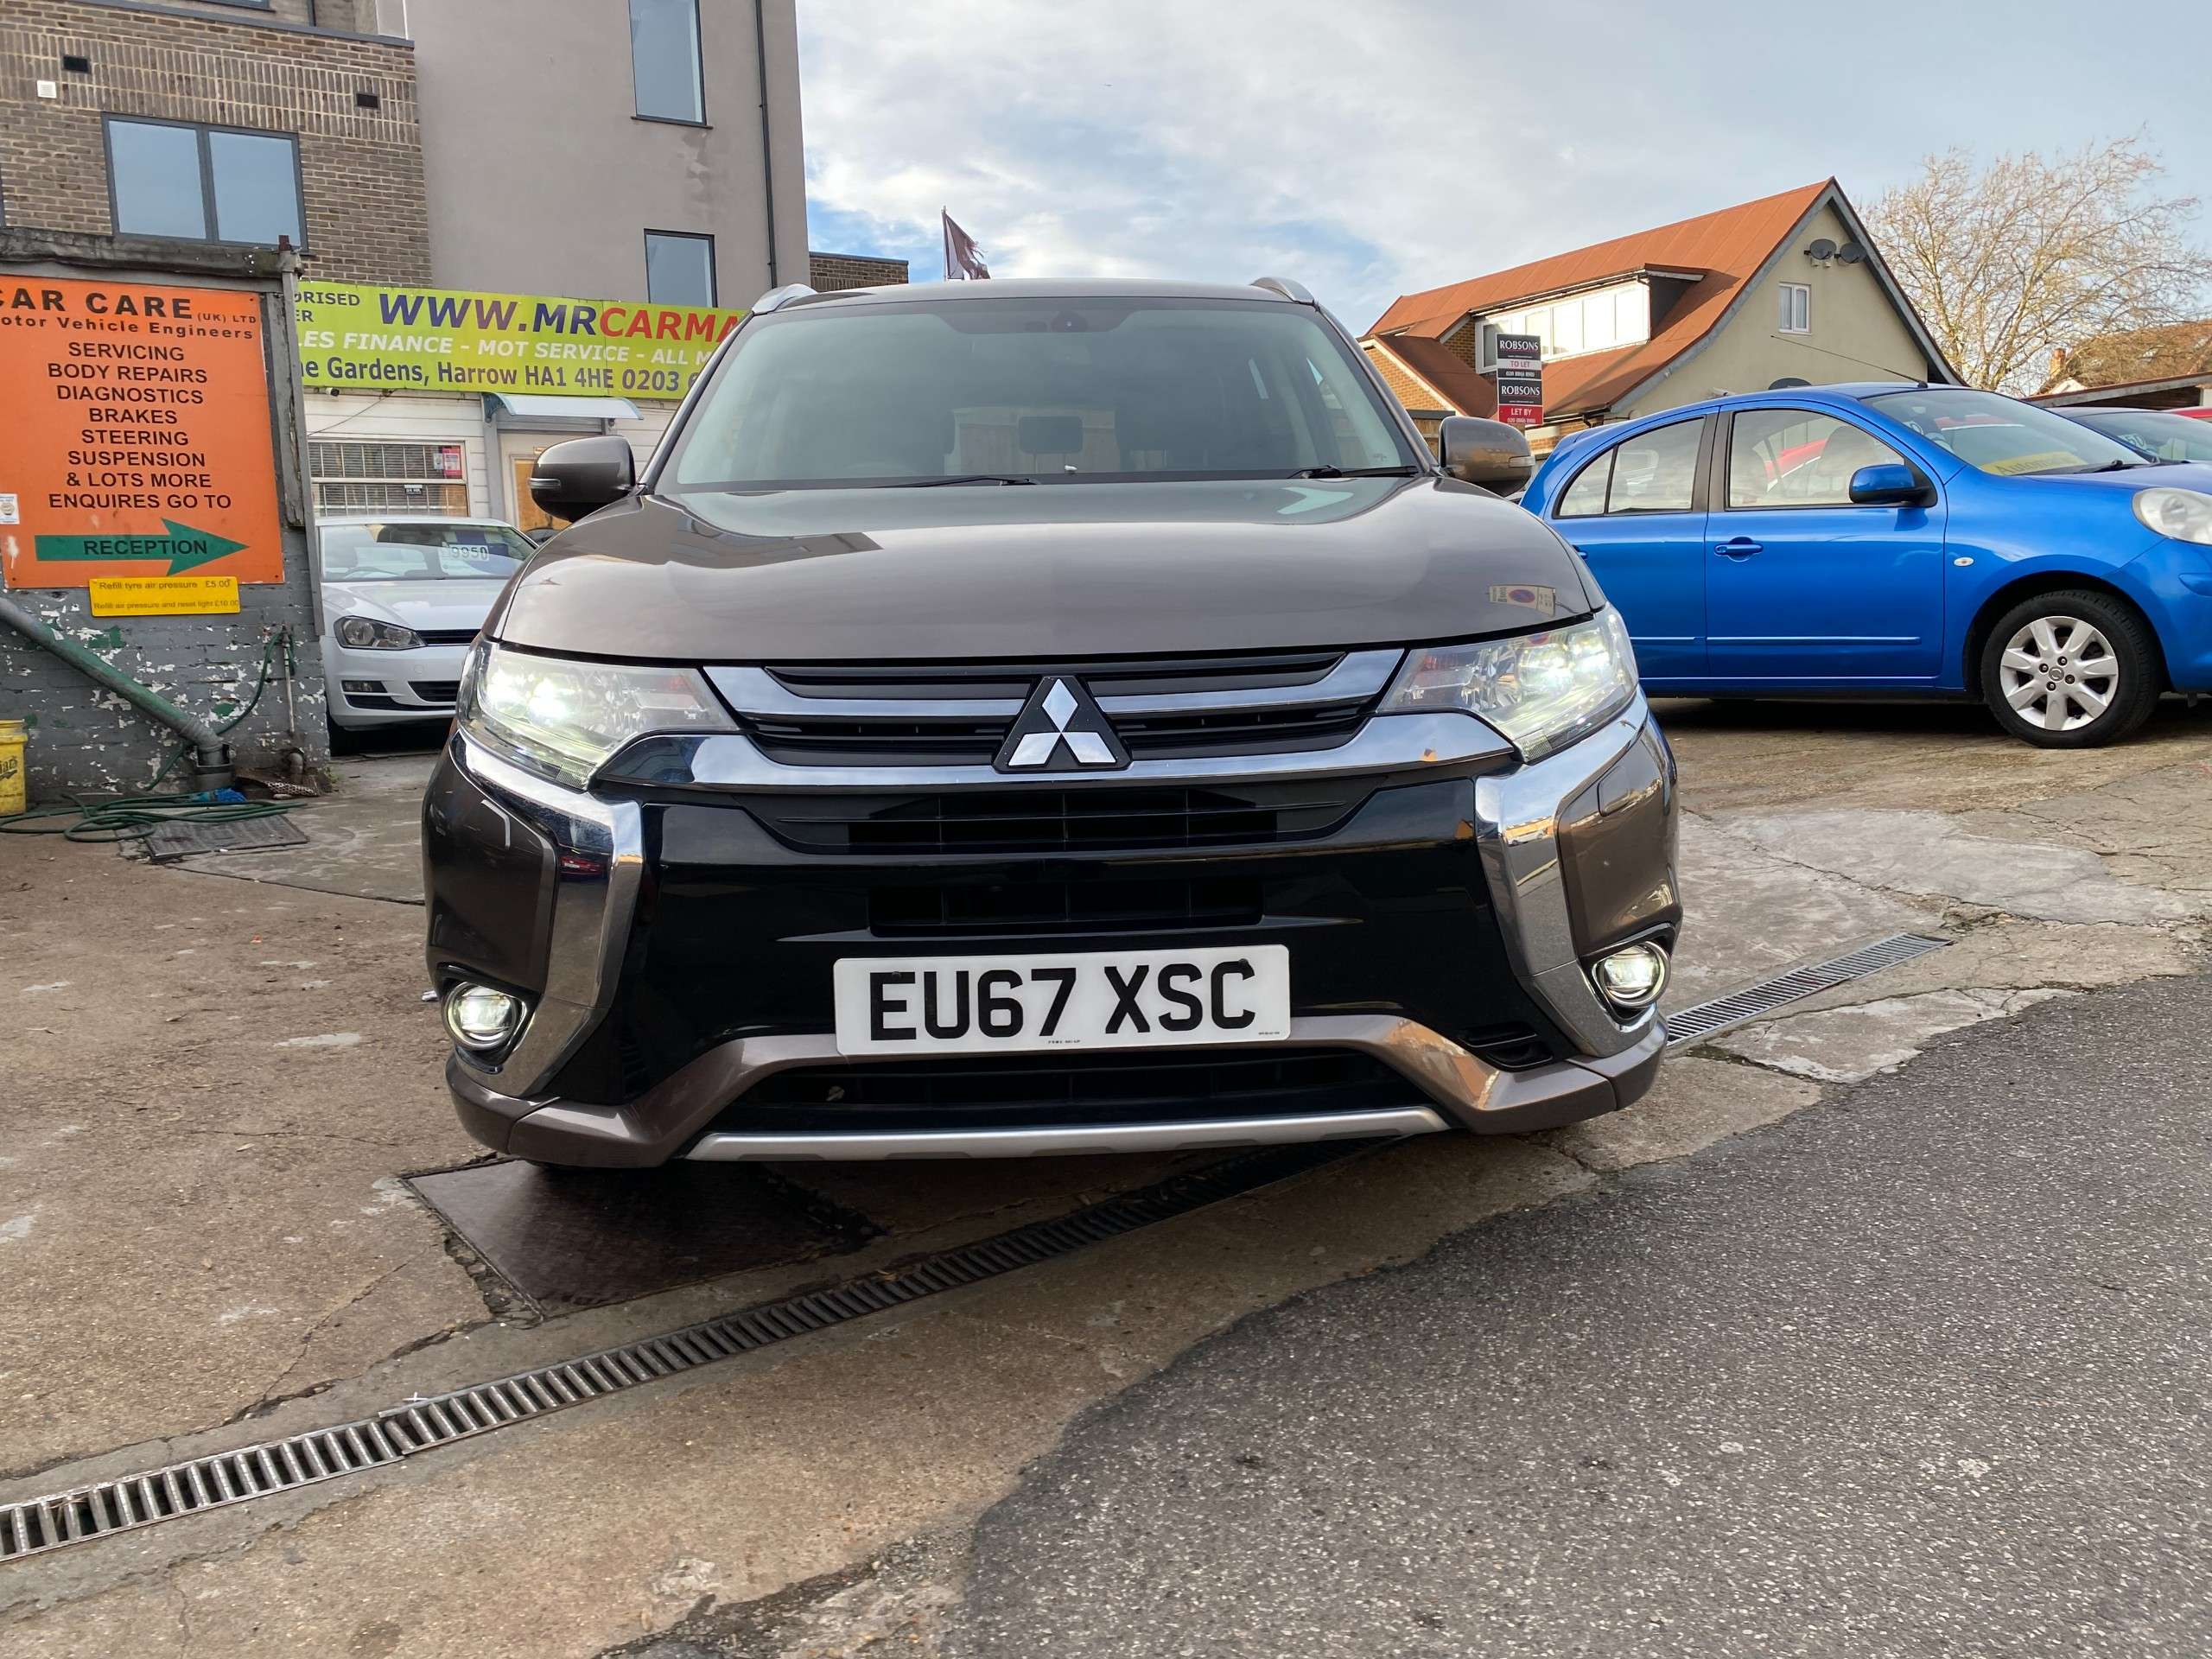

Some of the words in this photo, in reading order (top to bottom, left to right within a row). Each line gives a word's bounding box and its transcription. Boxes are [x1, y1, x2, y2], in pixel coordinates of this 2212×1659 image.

[0, 288, 66, 312] AR
[86, 292, 193, 320] CARE
[57, 316, 139, 334] Vehicle
[149, 322, 253, 340] Engineers
[197, 314, 226, 325] (UK)
[232, 315, 257, 325] LTD
[68, 342, 185, 361] SERVICING
[298, 330, 335, 348] ES
[343, 332, 454, 354] FINANCE
[477, 340, 529, 358] MOT
[534, 341, 630, 362] SERVICE
[650, 348, 689, 365] ALL
[1499, 340, 1539, 351] ROBSONS
[48, 362, 110, 379] BODY
[117, 365, 208, 384] REPAIRS
[327, 356, 429, 387] Gardens,
[437, 361, 518, 385] Harrow
[524, 365, 567, 387] HA1
[574, 366, 614, 389] 4HE
[621, 368, 680, 392] 0203
[56, 385, 204, 404] DIAGNOSTICS
[1501, 385, 1541, 396] ROBSONS
[89, 407, 178, 424] BRAKES
[81, 429, 188, 446] STEERING
[67, 450, 206, 467] SUSPENSION
[67, 472, 81, 486] &
[87, 473, 144, 487] LOTS
[150, 473, 213, 488] MORE
[48, 493, 160, 509] ENQUIRES
[167, 494, 198, 509] GO
[203, 494, 232, 509] TO
[83, 539, 208, 556] RECEPTION
[99, 582, 123, 590] Refill
[125, 582, 143, 592] tyre
[144, 581, 156, 589] air
[158, 581, 198, 591] pressure
[869, 968, 1077, 1041] EU67
[1103, 960, 1256, 1034] XSC
